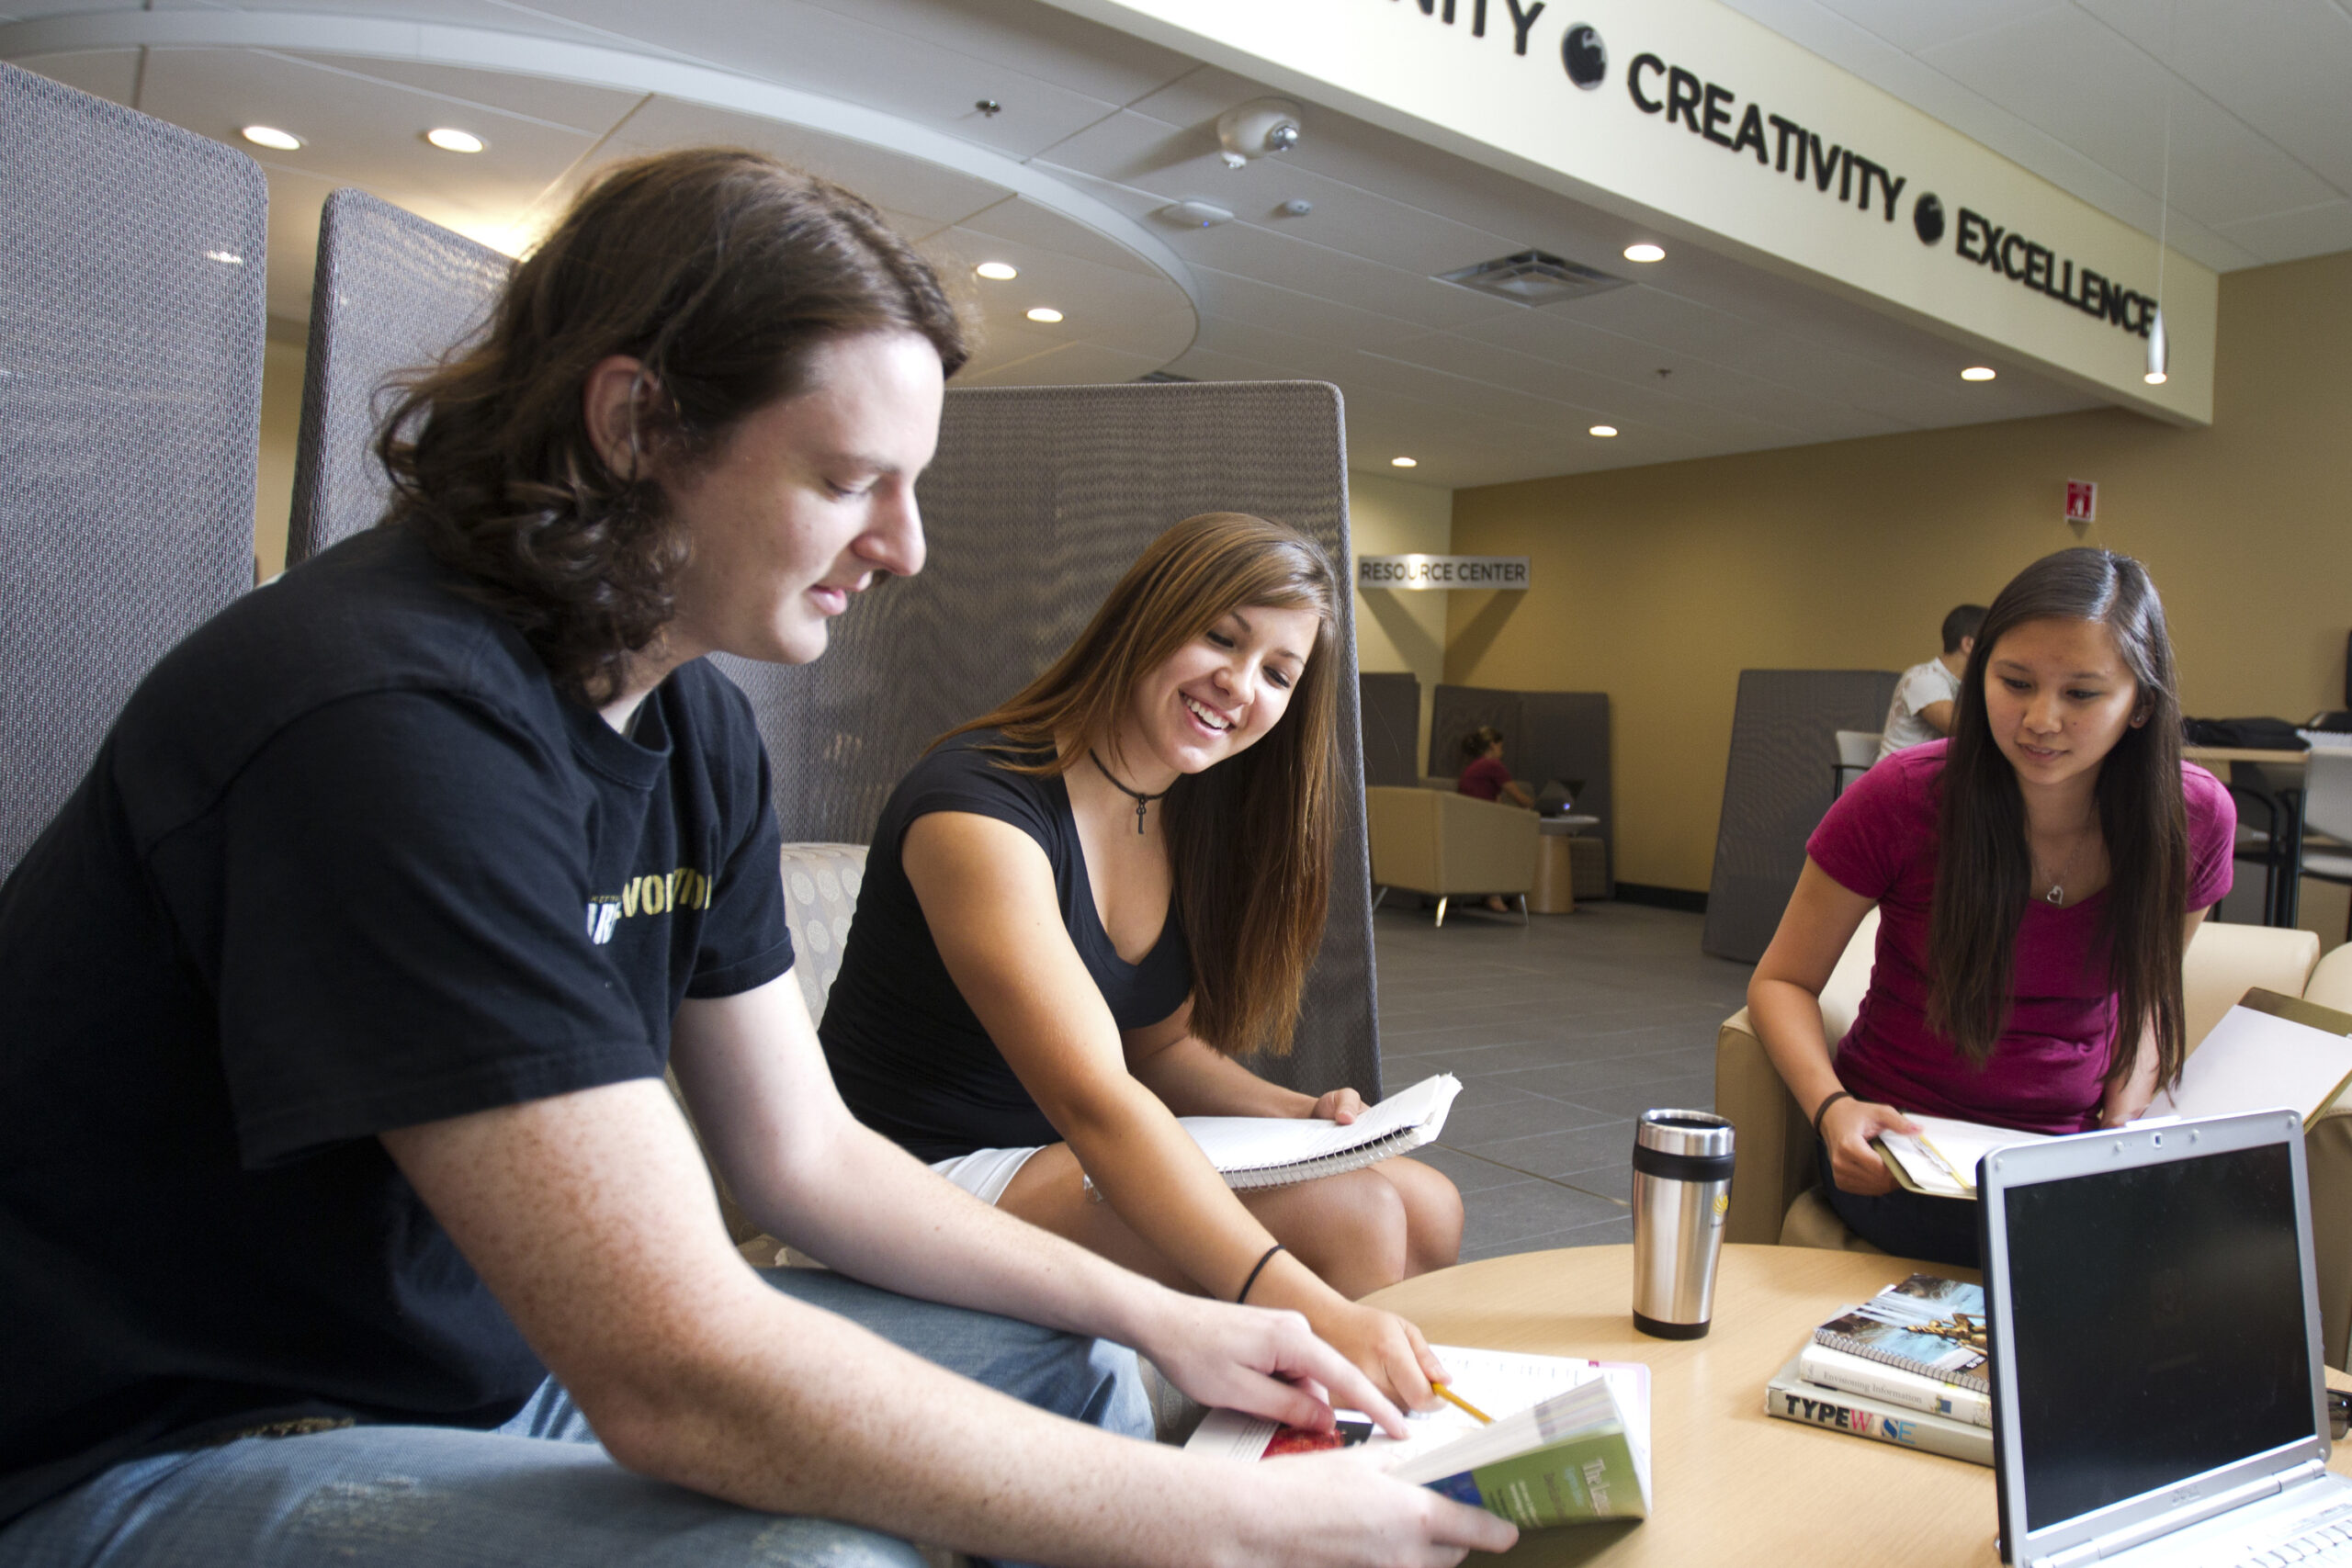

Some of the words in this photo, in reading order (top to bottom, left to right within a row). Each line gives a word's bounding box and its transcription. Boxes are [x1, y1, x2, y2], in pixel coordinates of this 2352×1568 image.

[1627, 52, 1906, 222] CREATIVITY
[1956, 207, 2159, 338] EXCELLENCE
[1361, 562, 1453, 581] RESOURCE
[1457, 562, 1526, 581] CENTER
[1824, 1371, 1871, 1393] Envisioning
[1872, 1382, 1922, 1404] Information
